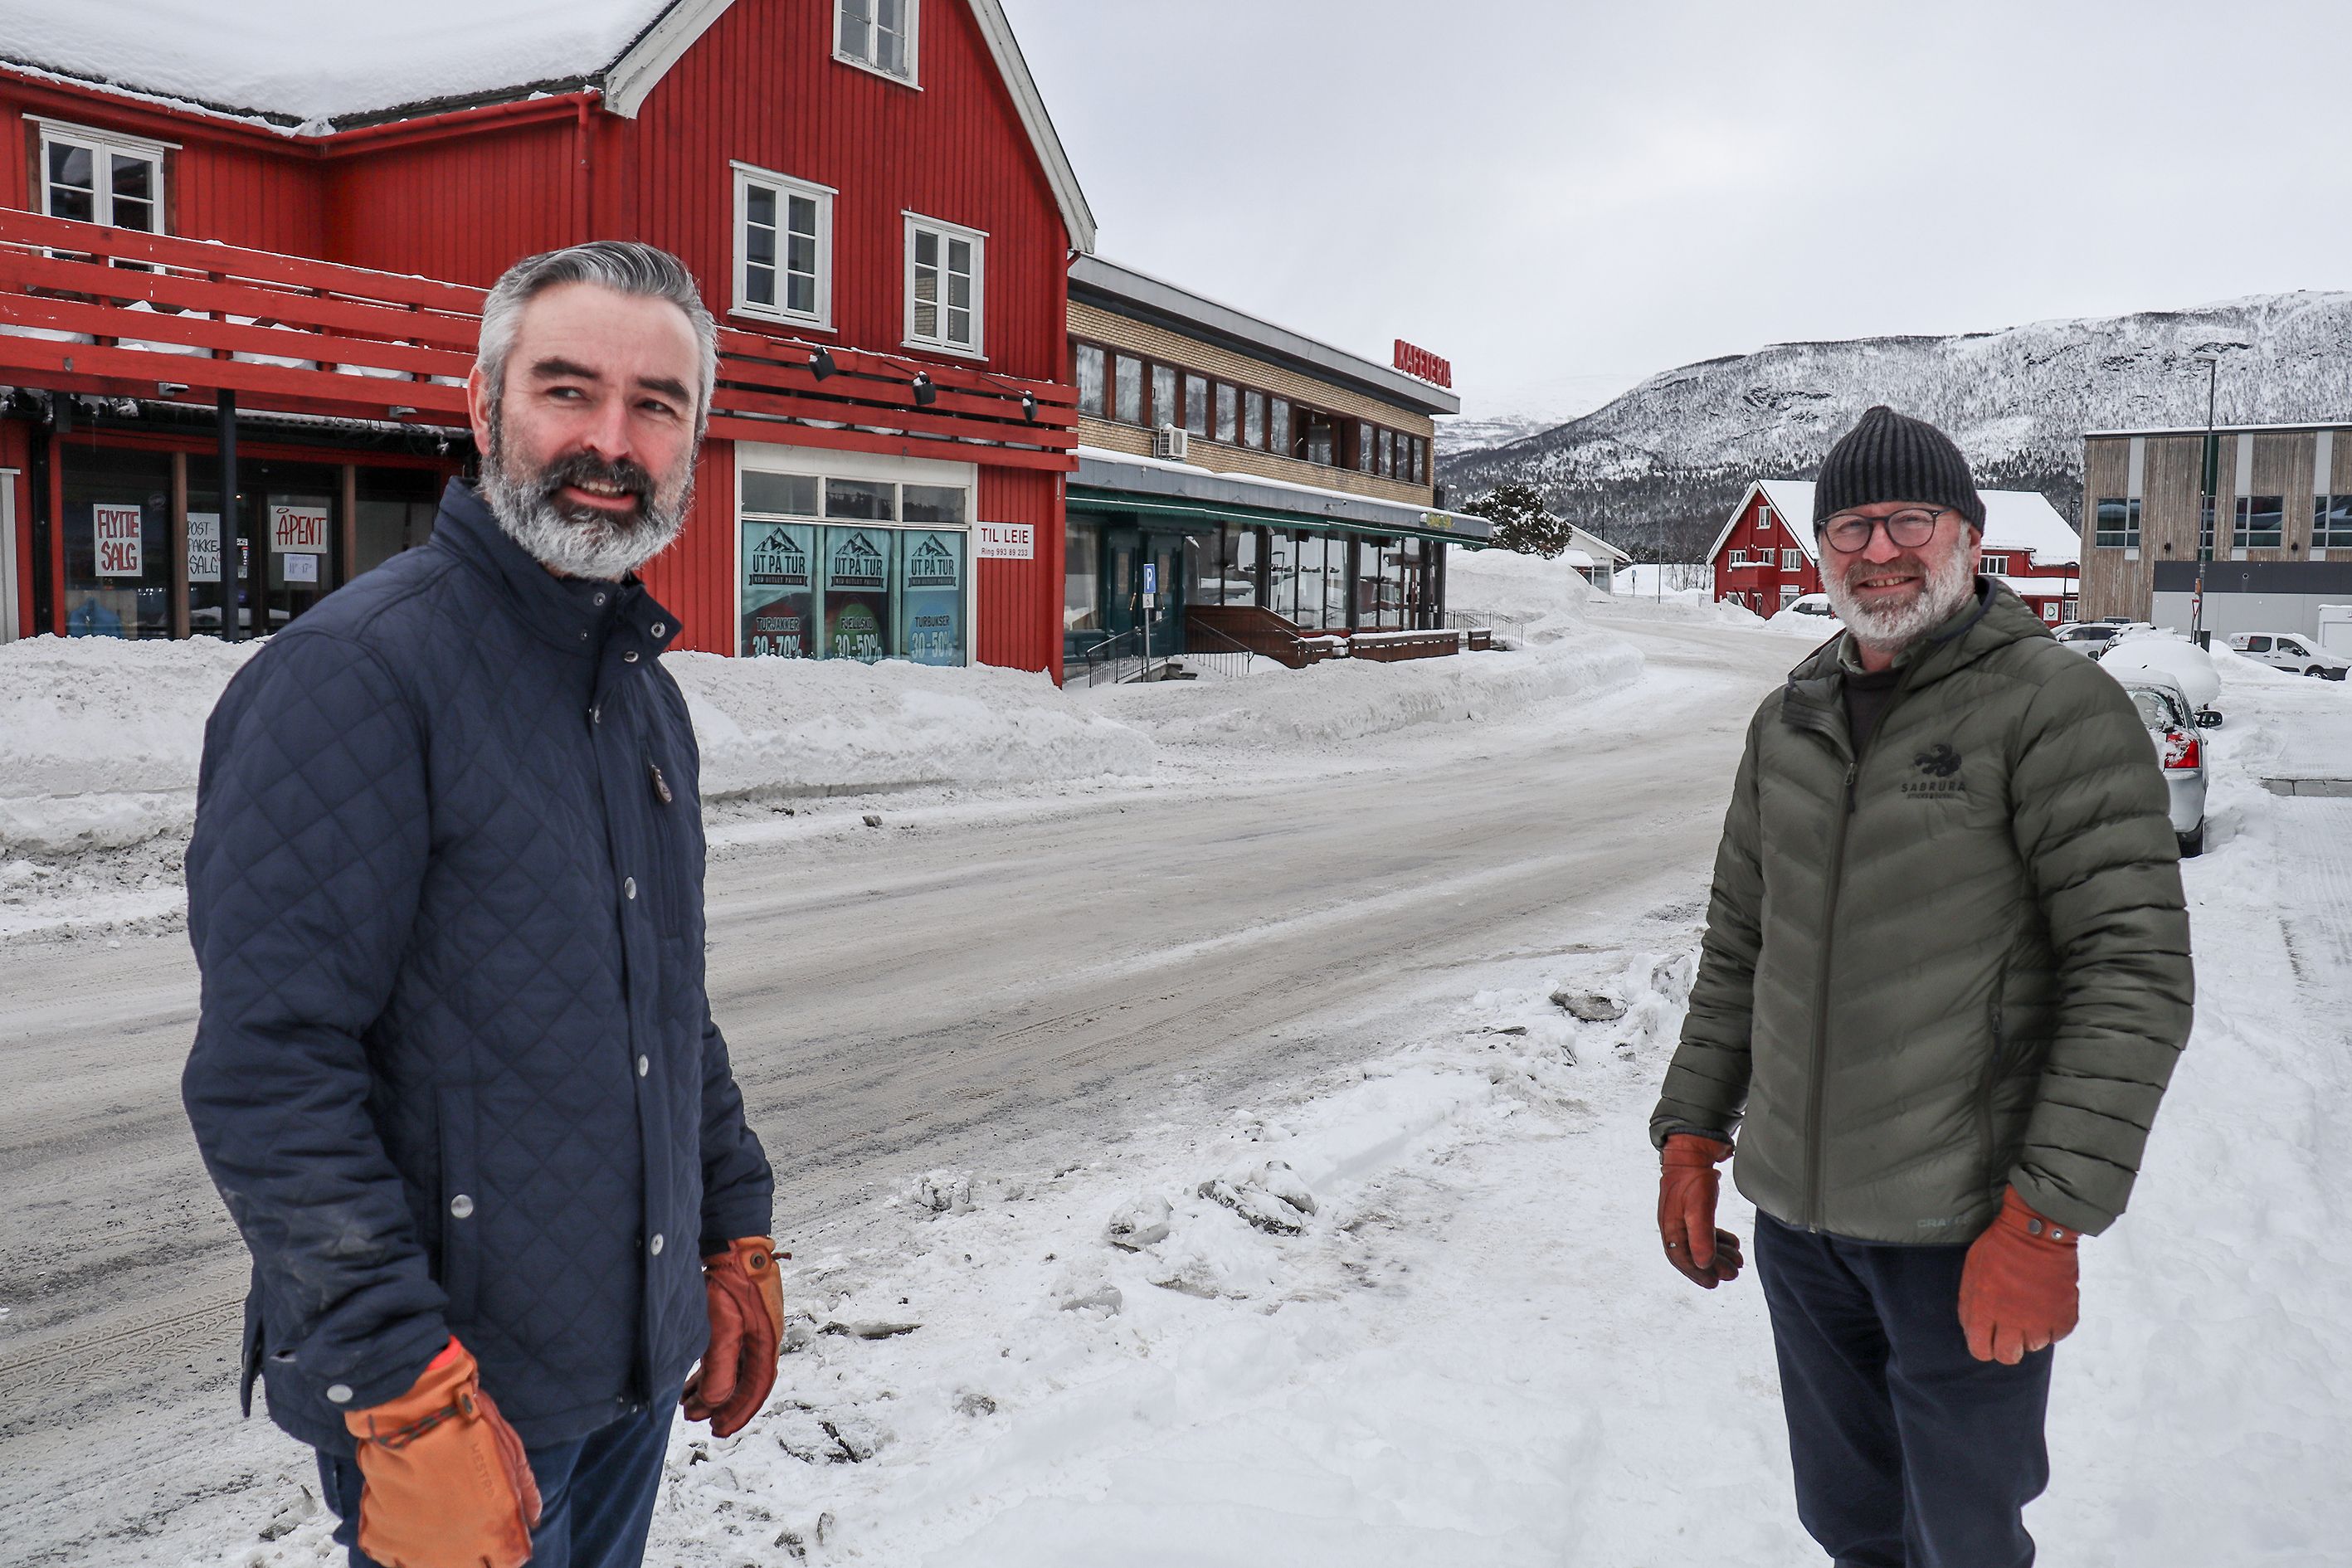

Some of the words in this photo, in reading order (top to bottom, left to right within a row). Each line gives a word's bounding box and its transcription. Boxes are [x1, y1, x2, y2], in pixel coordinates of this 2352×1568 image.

[1394, 338, 1452, 388] KAFETERIA
[97, 509, 139, 538] FLYTTE
[276, 508, 327, 546] ÅPENT
[981, 528, 999, 543] TIL
[1005, 529, 1029, 544] LEIE
[100, 540, 138, 571] SALG
[189, 554, 218, 574] SALG
[752, 554, 766, 572] UT
[768, 551, 782, 573] PÅ
[785, 555, 806, 574] TUR
[981, 548, 995, 557] Ring
[996, 548, 1007, 556] 993
[835, 557, 847, 574] UT
[849, 553, 861, 575] PÅ
[864, 558, 883, 576] TUR
[911, 559, 923, 576] UT
[924, 554, 936, 575] PÅ
[937, 559, 954, 575] TUR
[1147, 567, 1153, 590] P
[756, 616, 801, 631] TURJAKKER
[914, 615, 951, 628] TURBUKSER
[911, 631, 953, 659] 30-50%
[1901, 782, 1966, 793] SABRURA
